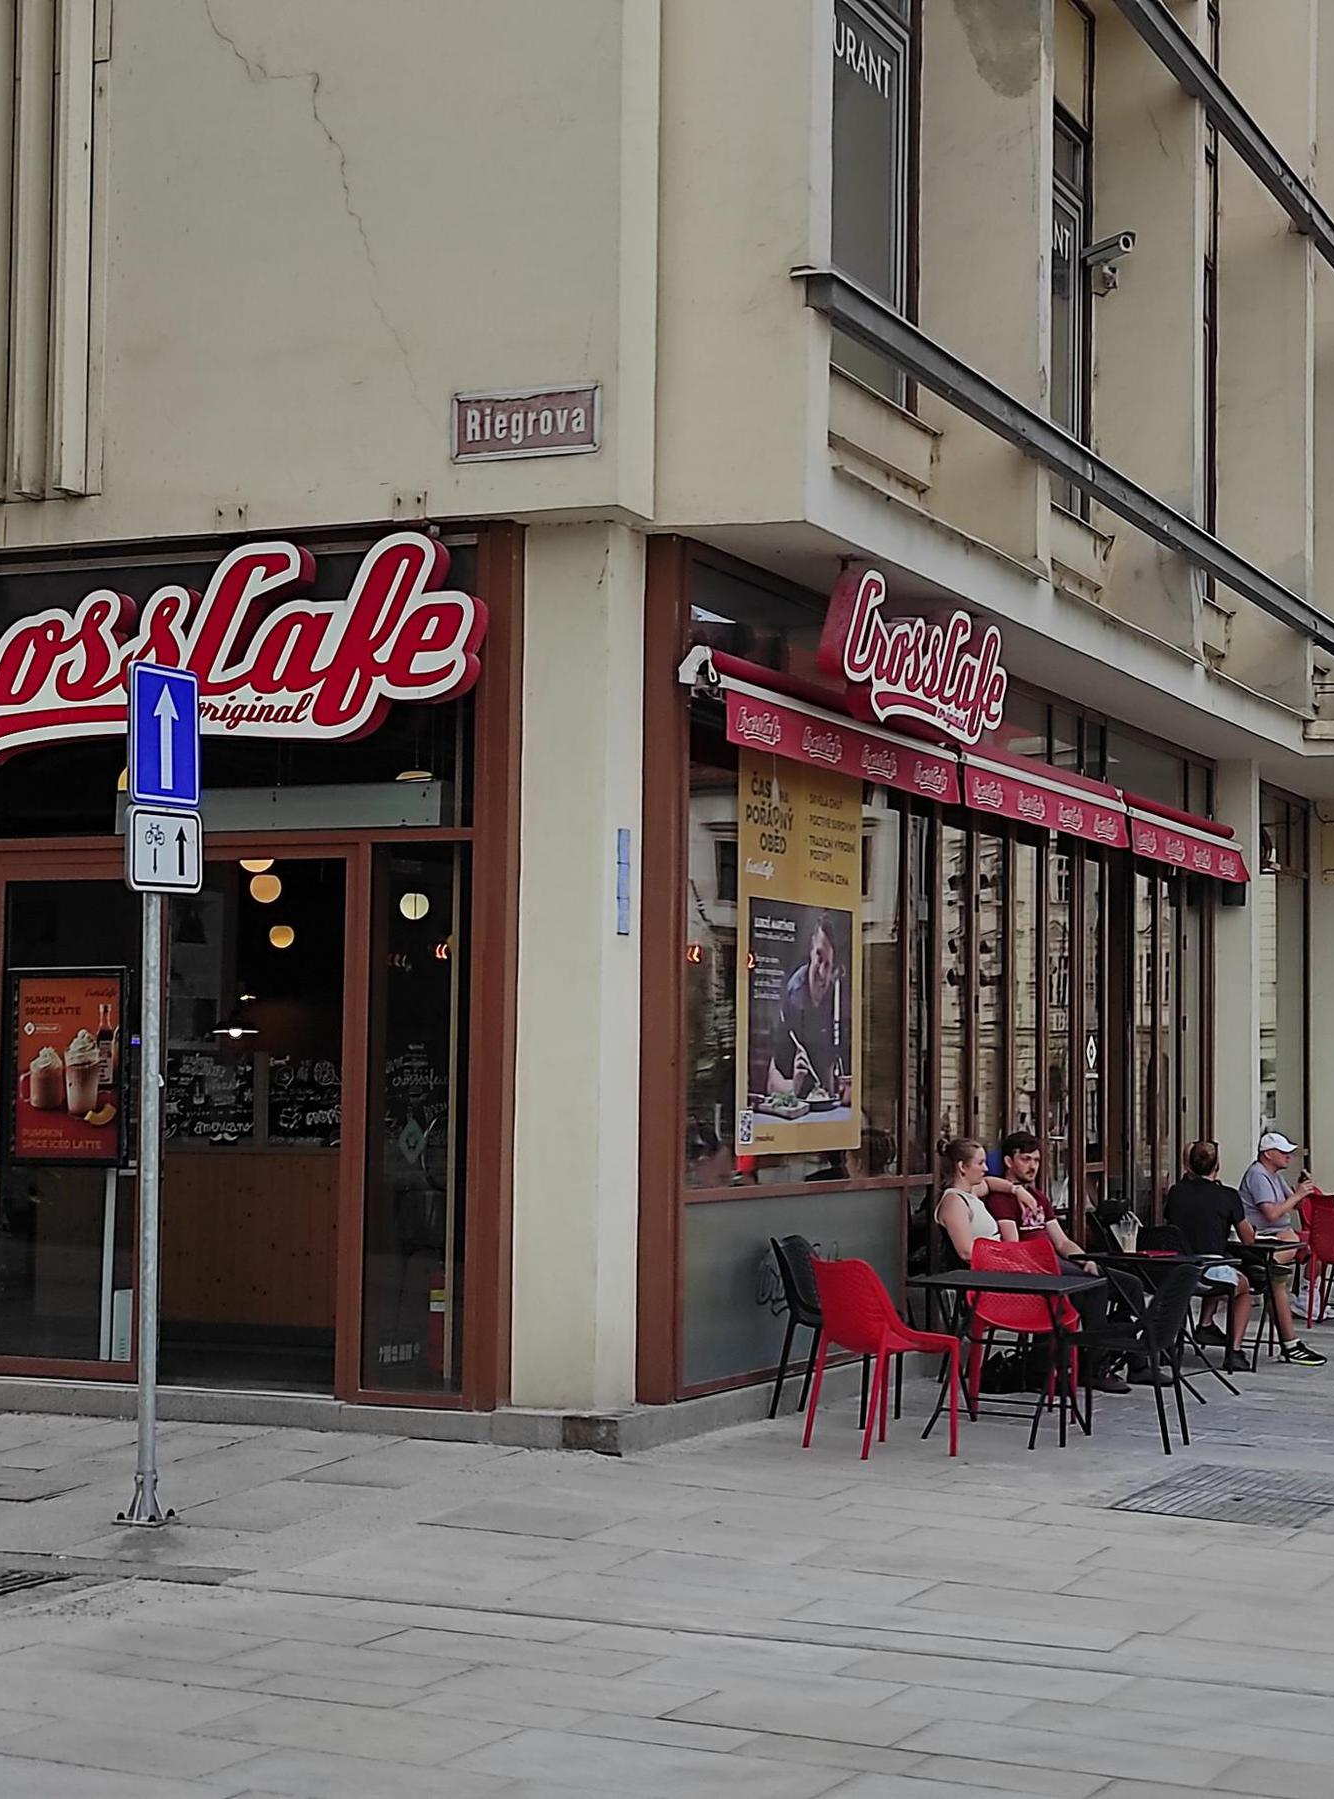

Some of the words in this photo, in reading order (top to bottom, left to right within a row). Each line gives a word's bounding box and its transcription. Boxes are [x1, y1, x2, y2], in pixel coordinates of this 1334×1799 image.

[467, 407, 586, 445] Riegrova
[845, 570, 1007, 745] CrossCafe
[750, 771, 772, 799] ČAS
[759, 829, 787, 855] OBĚD
[25, 996, 66, 1005] PUMPKIN
[25, 1006, 51, 1016] SPICE
[52, 1006, 81, 1016] LATTE
[22, 1128, 63, 1138] PUMPKIN
[72, 1140, 102, 1150] LATTE
